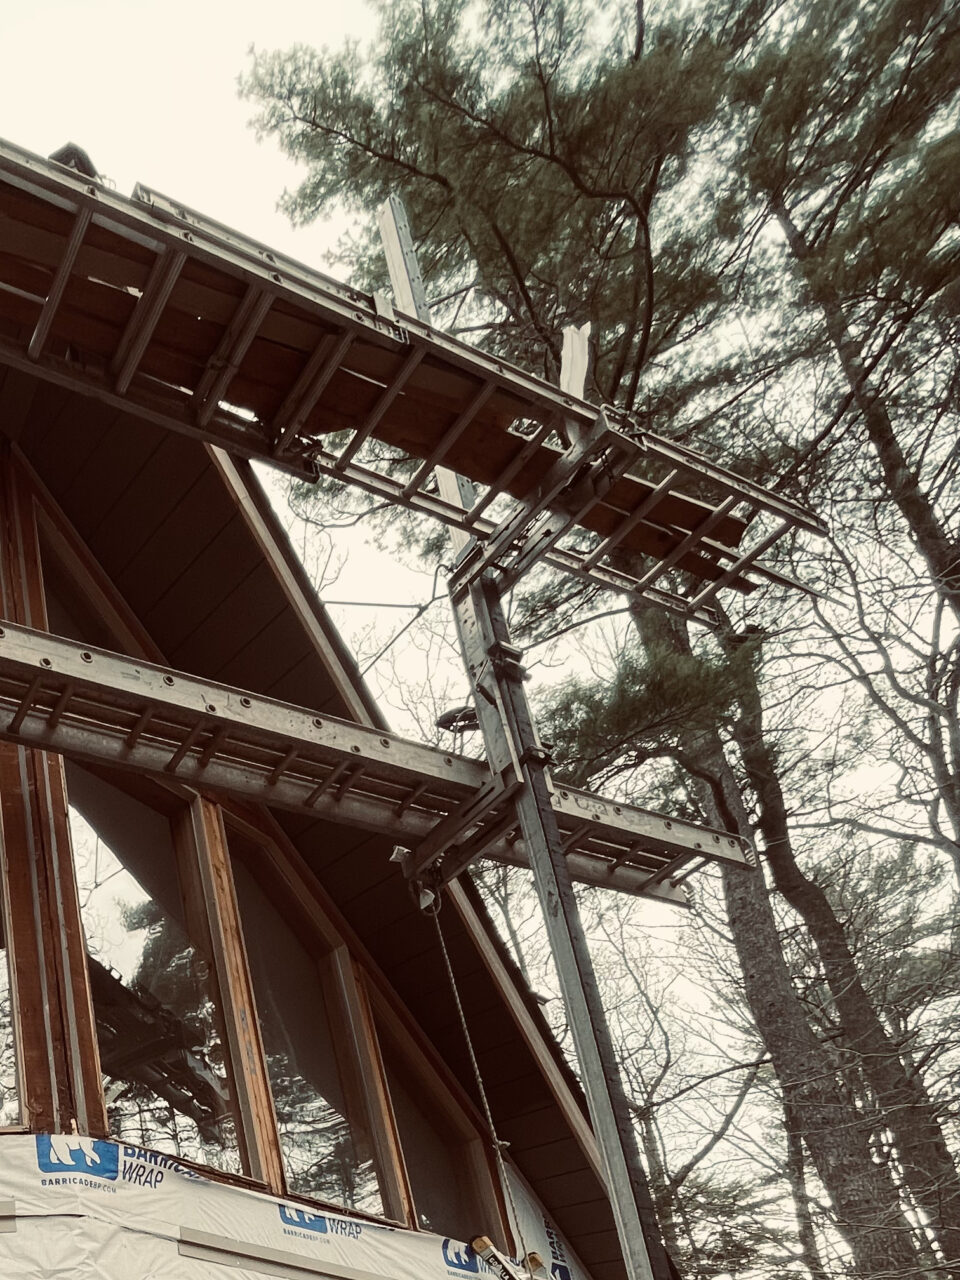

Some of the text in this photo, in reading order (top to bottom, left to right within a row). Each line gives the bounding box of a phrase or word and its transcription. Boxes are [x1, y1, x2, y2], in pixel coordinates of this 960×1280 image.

[122, 1160, 164, 1190] WRAP
[327, 1217, 362, 1240] WRAP
[488, 1257, 510, 1280] GOLLA
